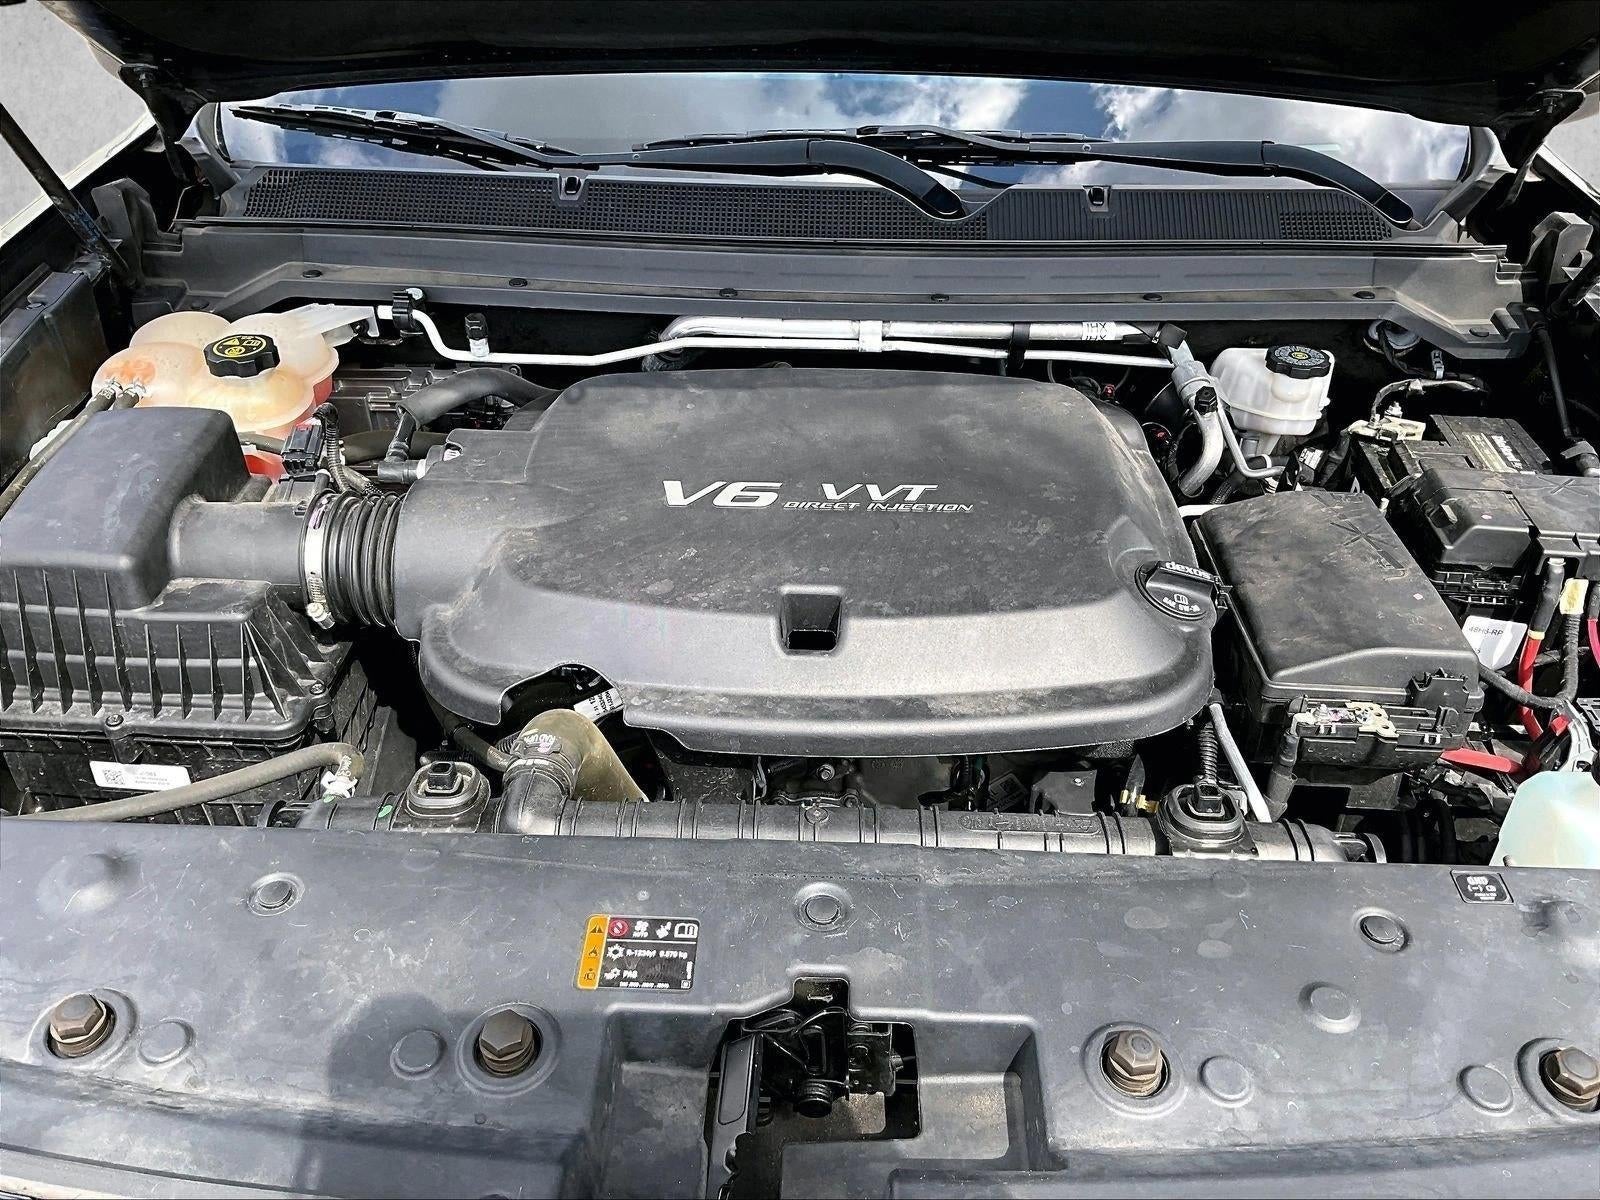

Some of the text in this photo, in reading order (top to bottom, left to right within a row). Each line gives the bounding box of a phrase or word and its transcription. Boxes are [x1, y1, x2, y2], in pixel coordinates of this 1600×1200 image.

[662, 480, 783, 508] V6
[821, 483, 938, 501] VVT
[783, 501, 974, 512] DIRECT INJECTION
[1165, 561, 1211, 580] dexos
